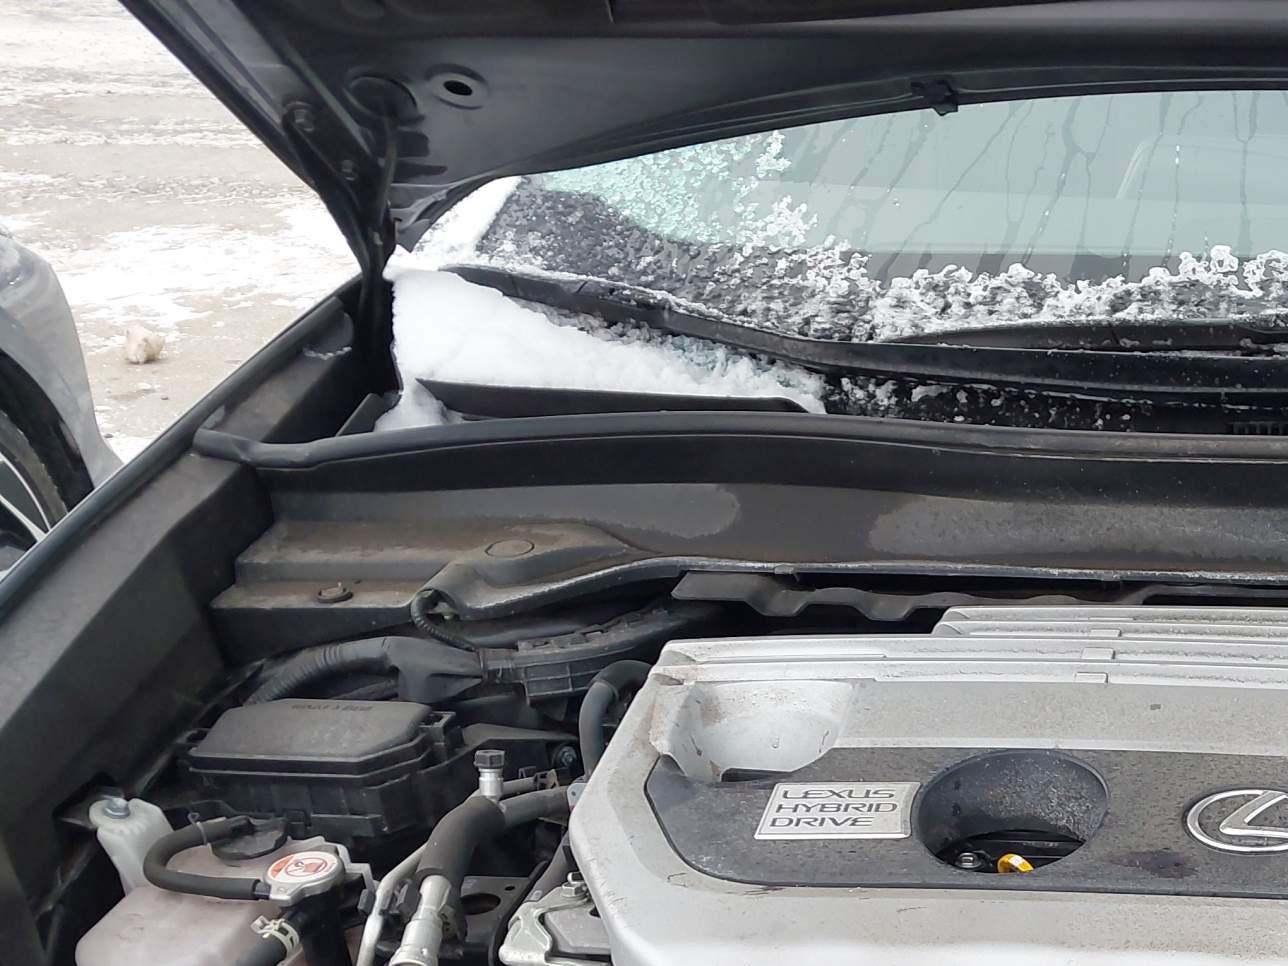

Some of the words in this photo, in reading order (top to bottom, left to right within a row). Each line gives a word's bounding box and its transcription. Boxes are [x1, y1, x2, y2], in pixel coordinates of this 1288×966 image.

[783, 789, 897, 799] LEXUS
[775, 802, 898, 813] HYBRID
[769, 816, 876, 827] DRIVE
